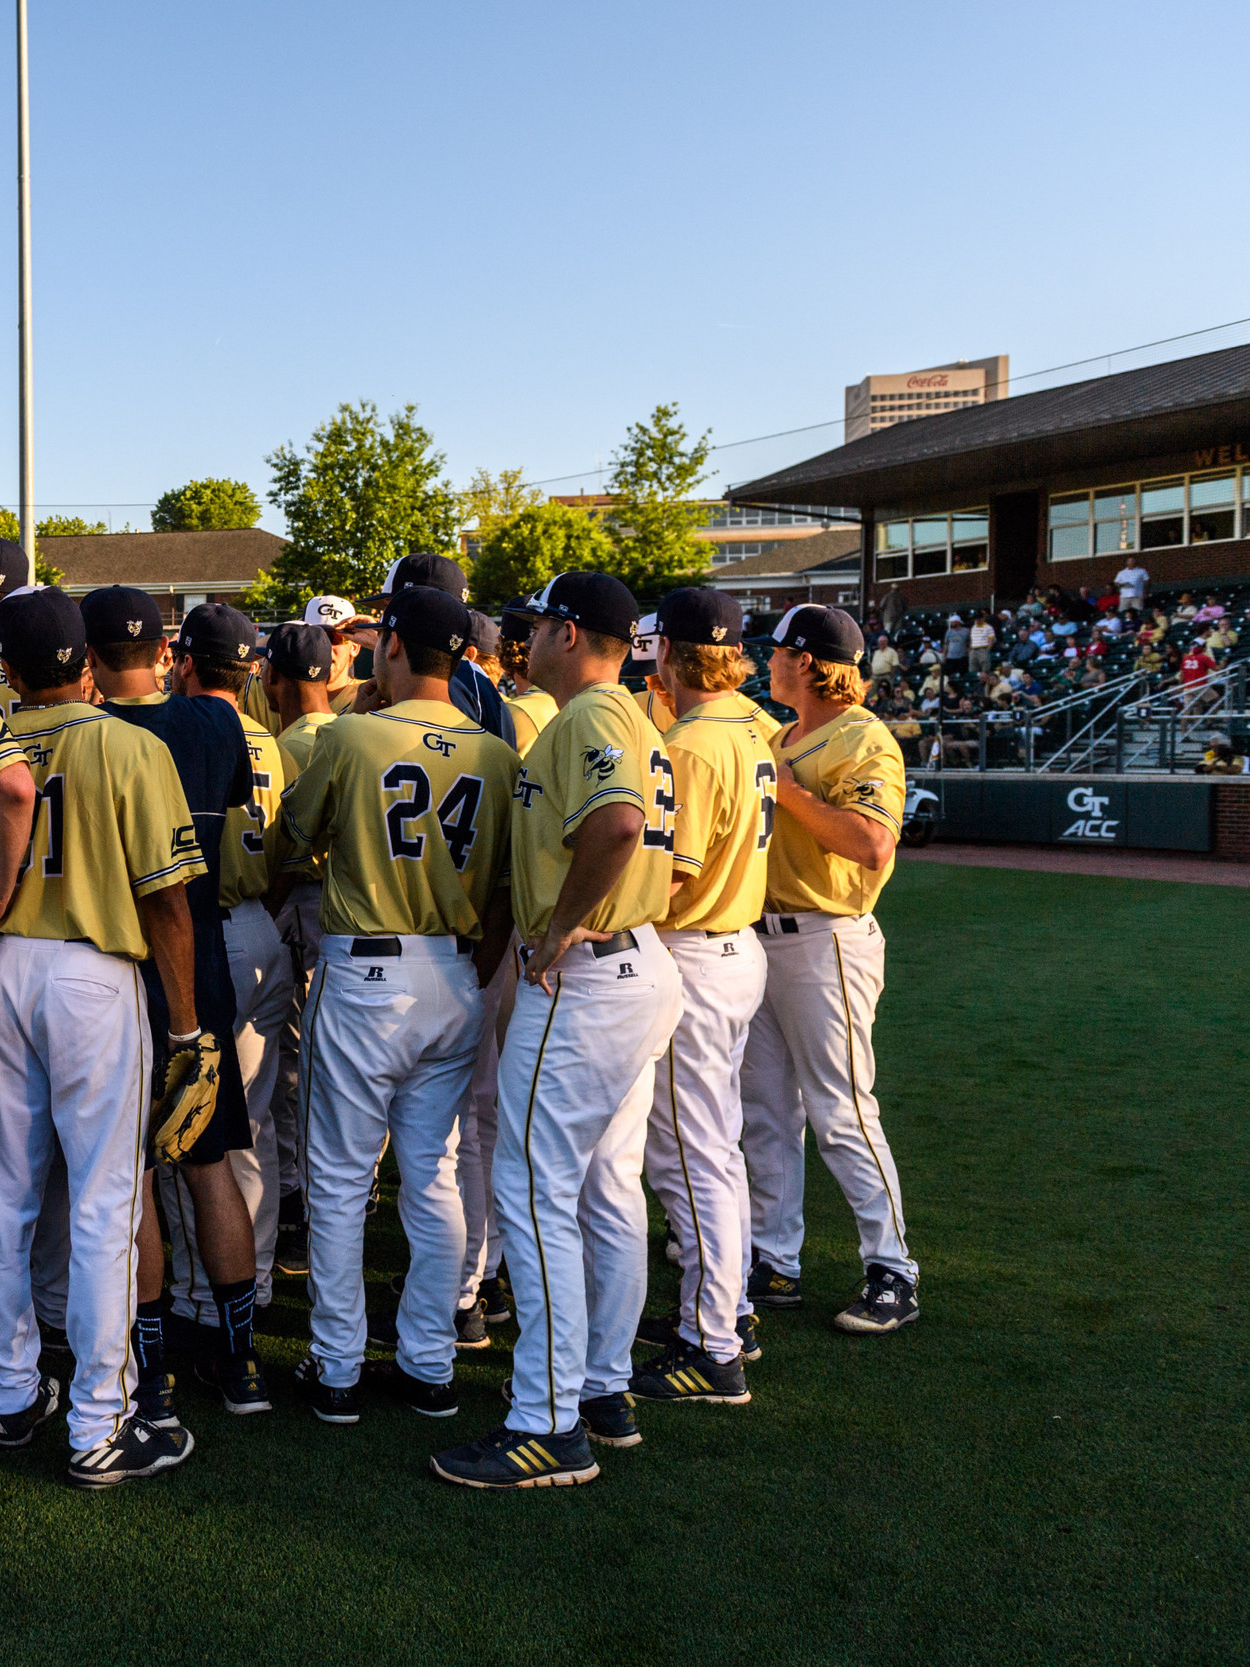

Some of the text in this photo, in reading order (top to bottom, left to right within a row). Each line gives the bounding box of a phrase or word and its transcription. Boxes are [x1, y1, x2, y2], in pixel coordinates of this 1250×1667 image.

[317, 603, 343, 620] GT
[631, 635, 653, 652] GT
[423, 732, 456, 758] GT
[1067, 787, 1110, 817] GT
[381, 761, 485, 873] 24
[1062, 819, 1120, 838] ACC
